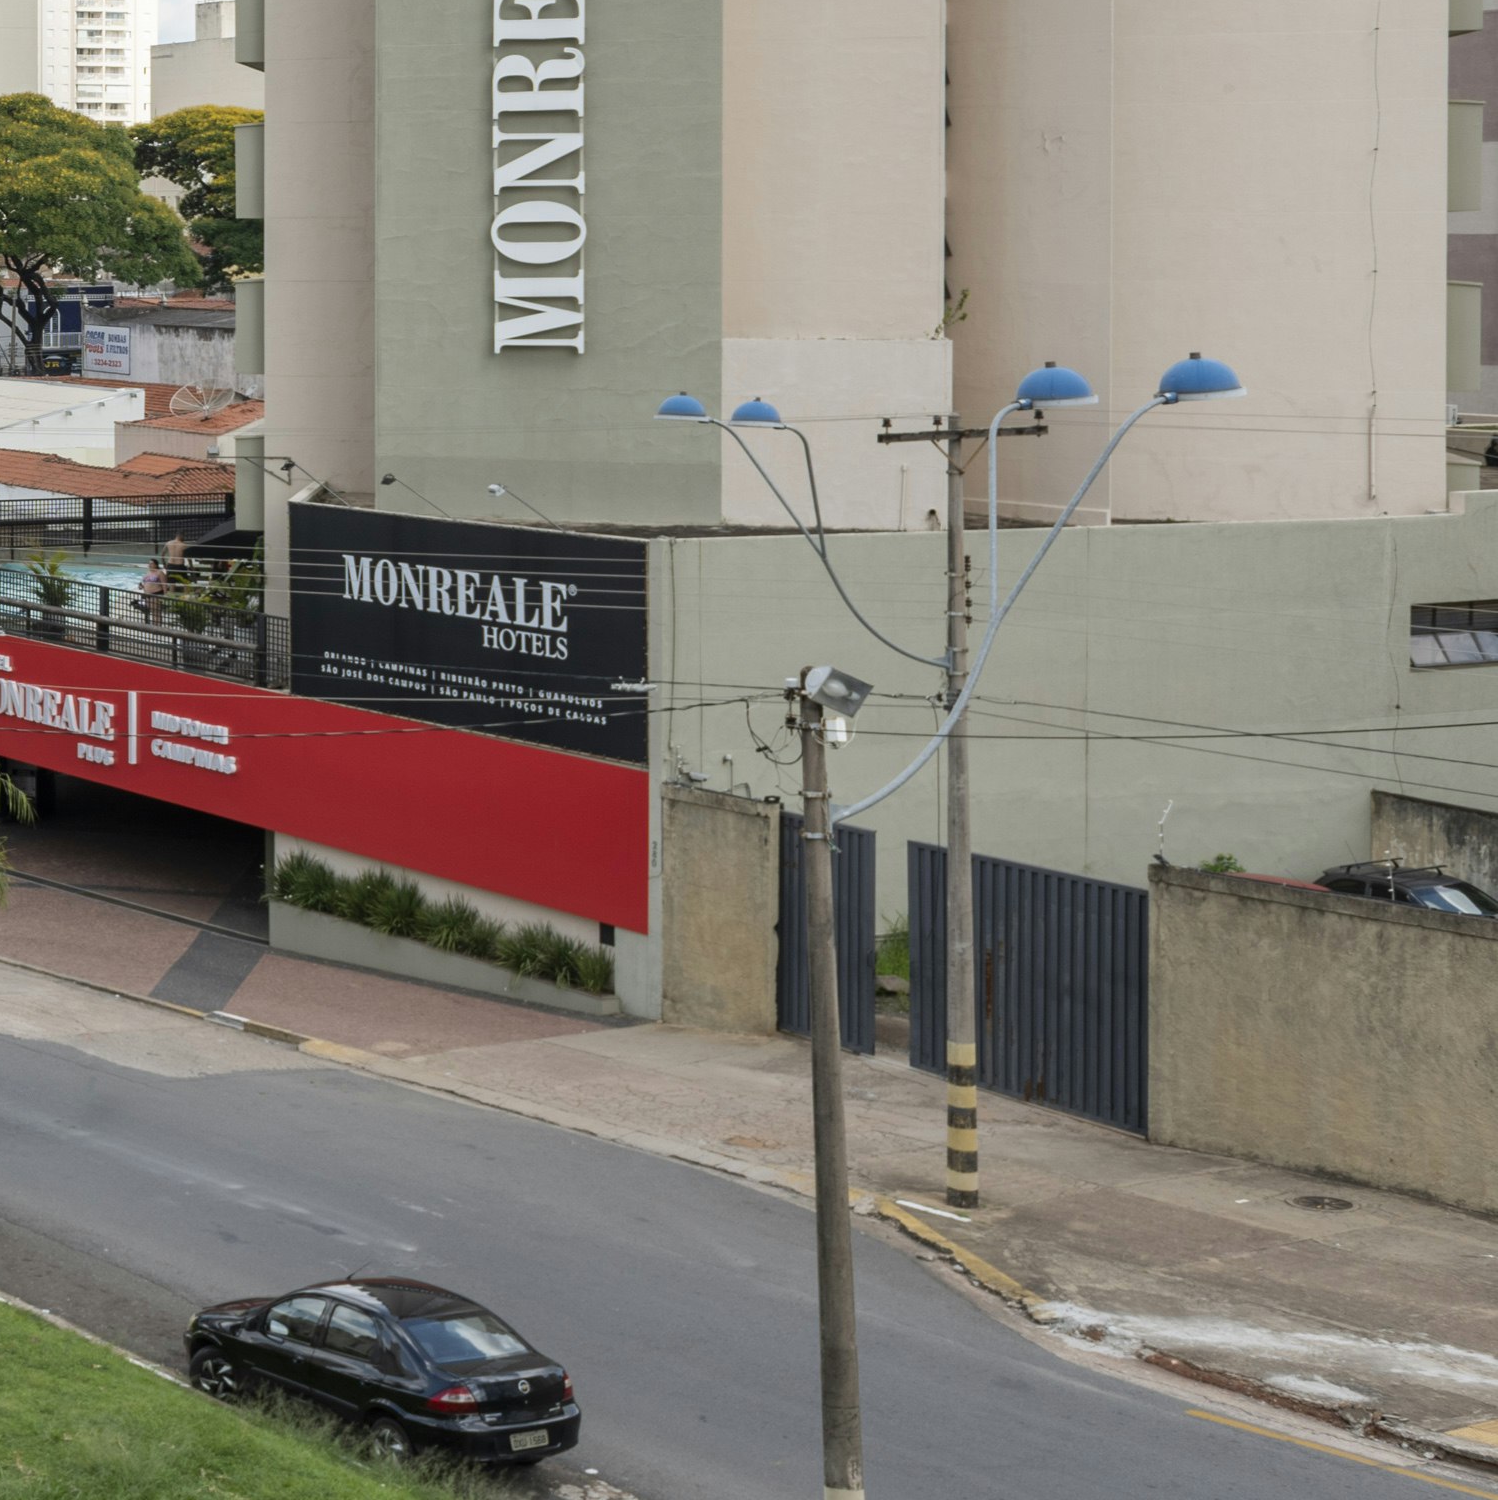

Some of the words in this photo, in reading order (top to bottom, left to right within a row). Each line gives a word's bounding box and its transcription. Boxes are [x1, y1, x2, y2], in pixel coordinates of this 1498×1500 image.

[481, 625, 568, 660] HOTELS
[321, 664, 338, 674] SÃO
[342, 668, 363, 679] JOSÉ
[366, 673, 385, 683] DOS
[388, 677, 427, 691] CAMPOS
[439, 687, 458, 698] SÃO
[463, 692, 495, 705] PAULO
[509, 699, 543, 714] POÇOS
[548, 707, 561, 717] DE
[565, 710, 607, 725] CALDAS
[379, 662, 427, 677] CAMPINAS
[440, 672, 488, 688] RIBEIRÃO
[492, 681, 524, 694] PRETO
[538, 690, 603, 708] GUARULHOS
[151, 711, 229, 745] MIDTOWN
[77, 742, 115, 766] PLUS
[151, 739, 237, 774] CAMPINAS
